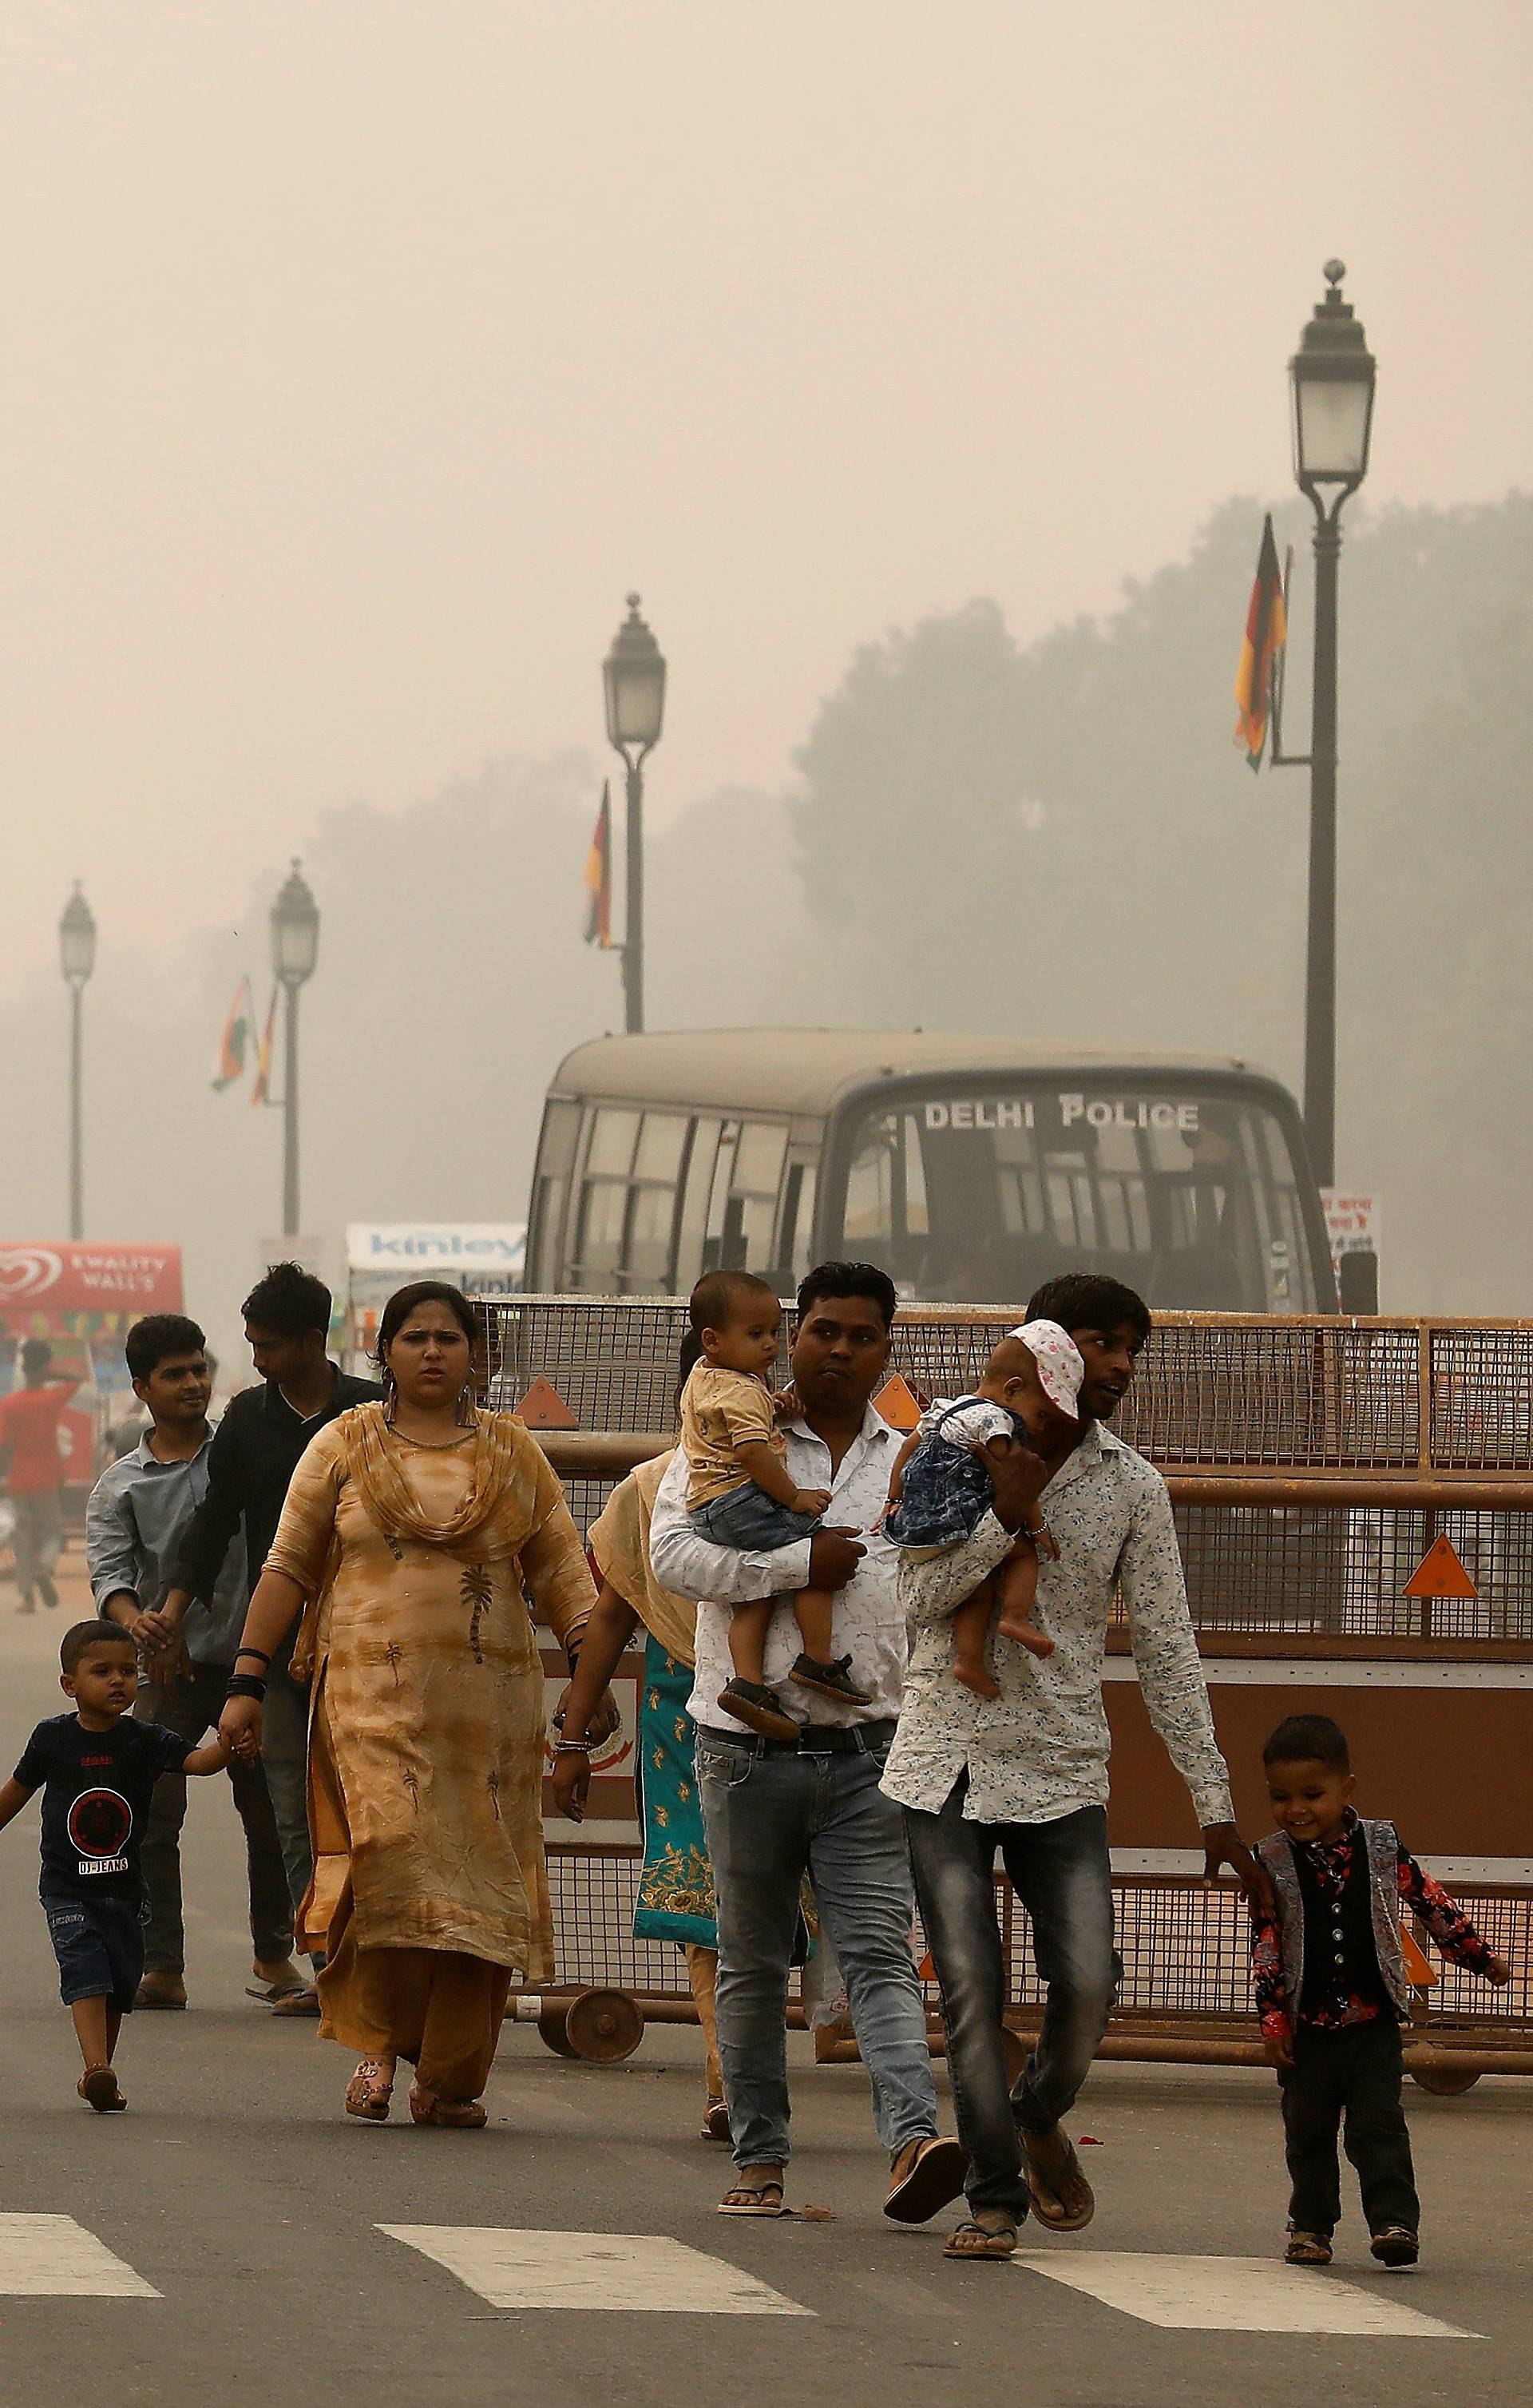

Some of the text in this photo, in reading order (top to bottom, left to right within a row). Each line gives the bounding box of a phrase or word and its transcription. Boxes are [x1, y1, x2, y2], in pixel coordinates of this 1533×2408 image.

[925, 1093, 1198, 1131] DELHI POLICE
[370, 1232, 527, 1259] kinley
